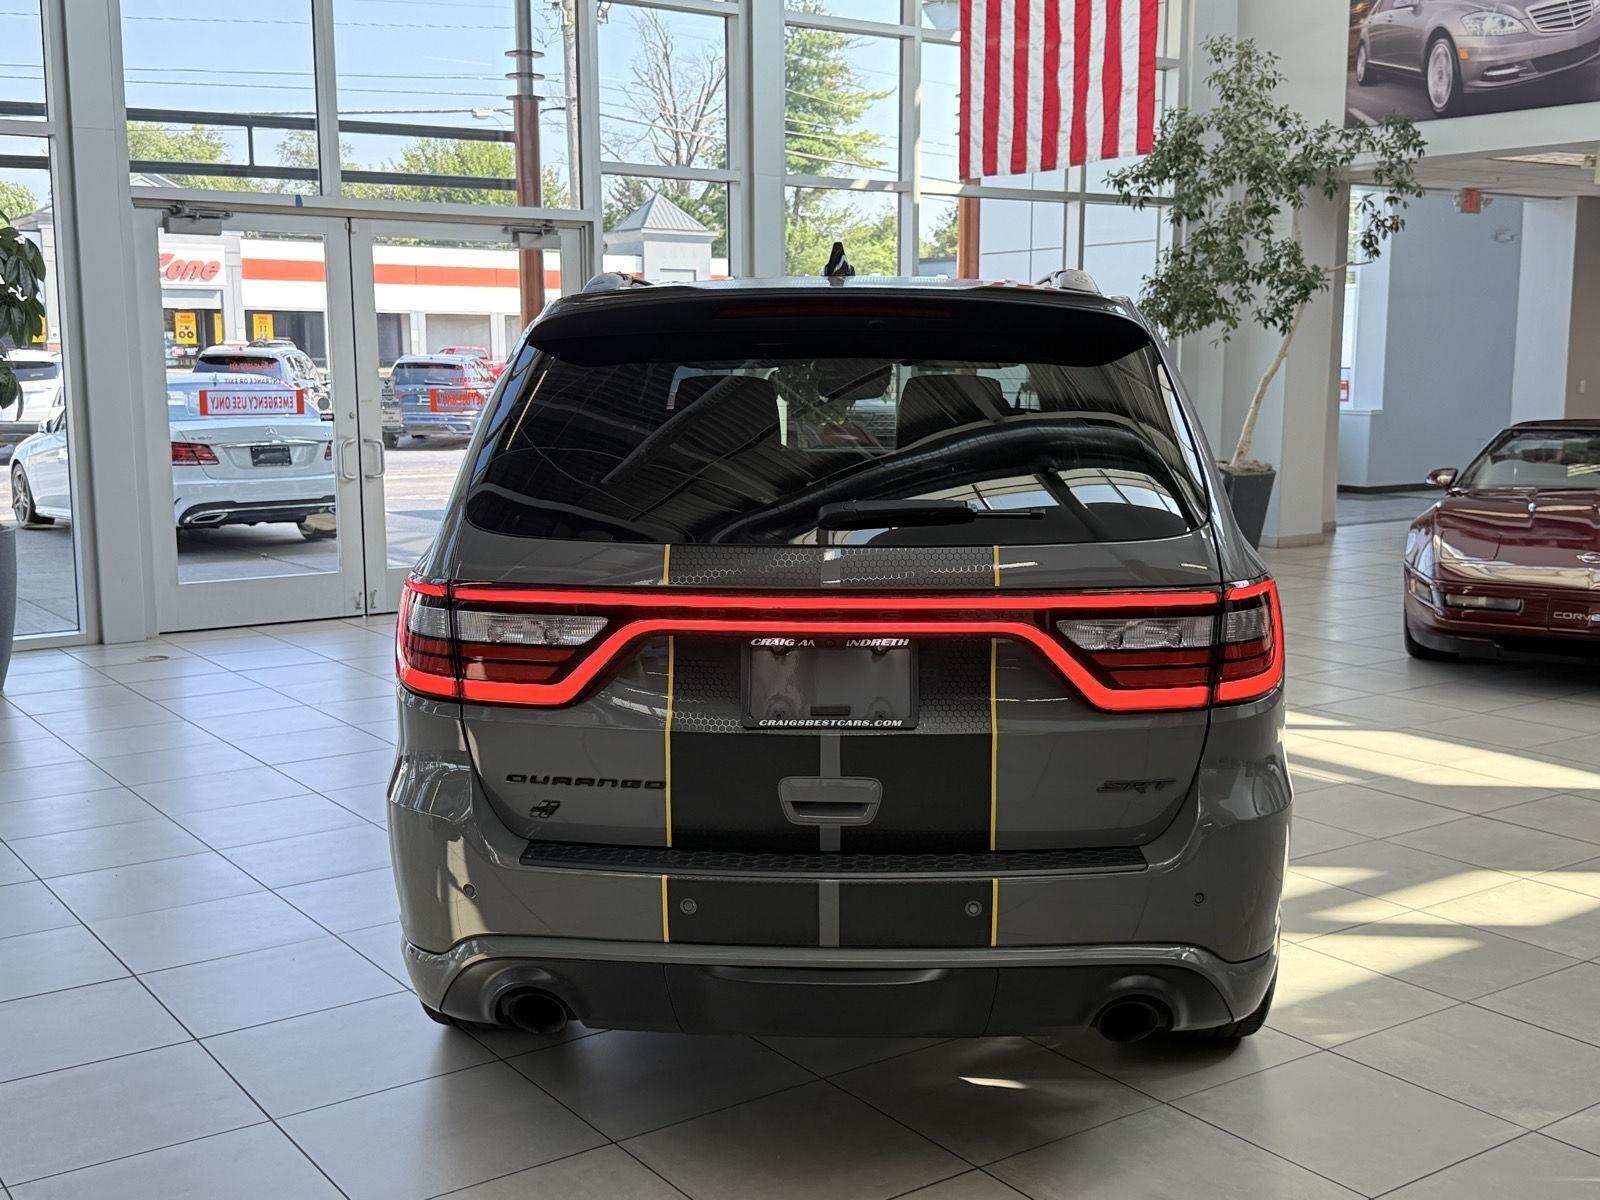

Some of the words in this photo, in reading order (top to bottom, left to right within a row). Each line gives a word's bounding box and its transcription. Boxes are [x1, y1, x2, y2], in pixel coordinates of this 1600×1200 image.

[751, 638, 795, 647] CRAIG
[759, 719, 903, 727] CRAIGSBESTCARS.COM
[505, 774, 667, 790] DURANGO
